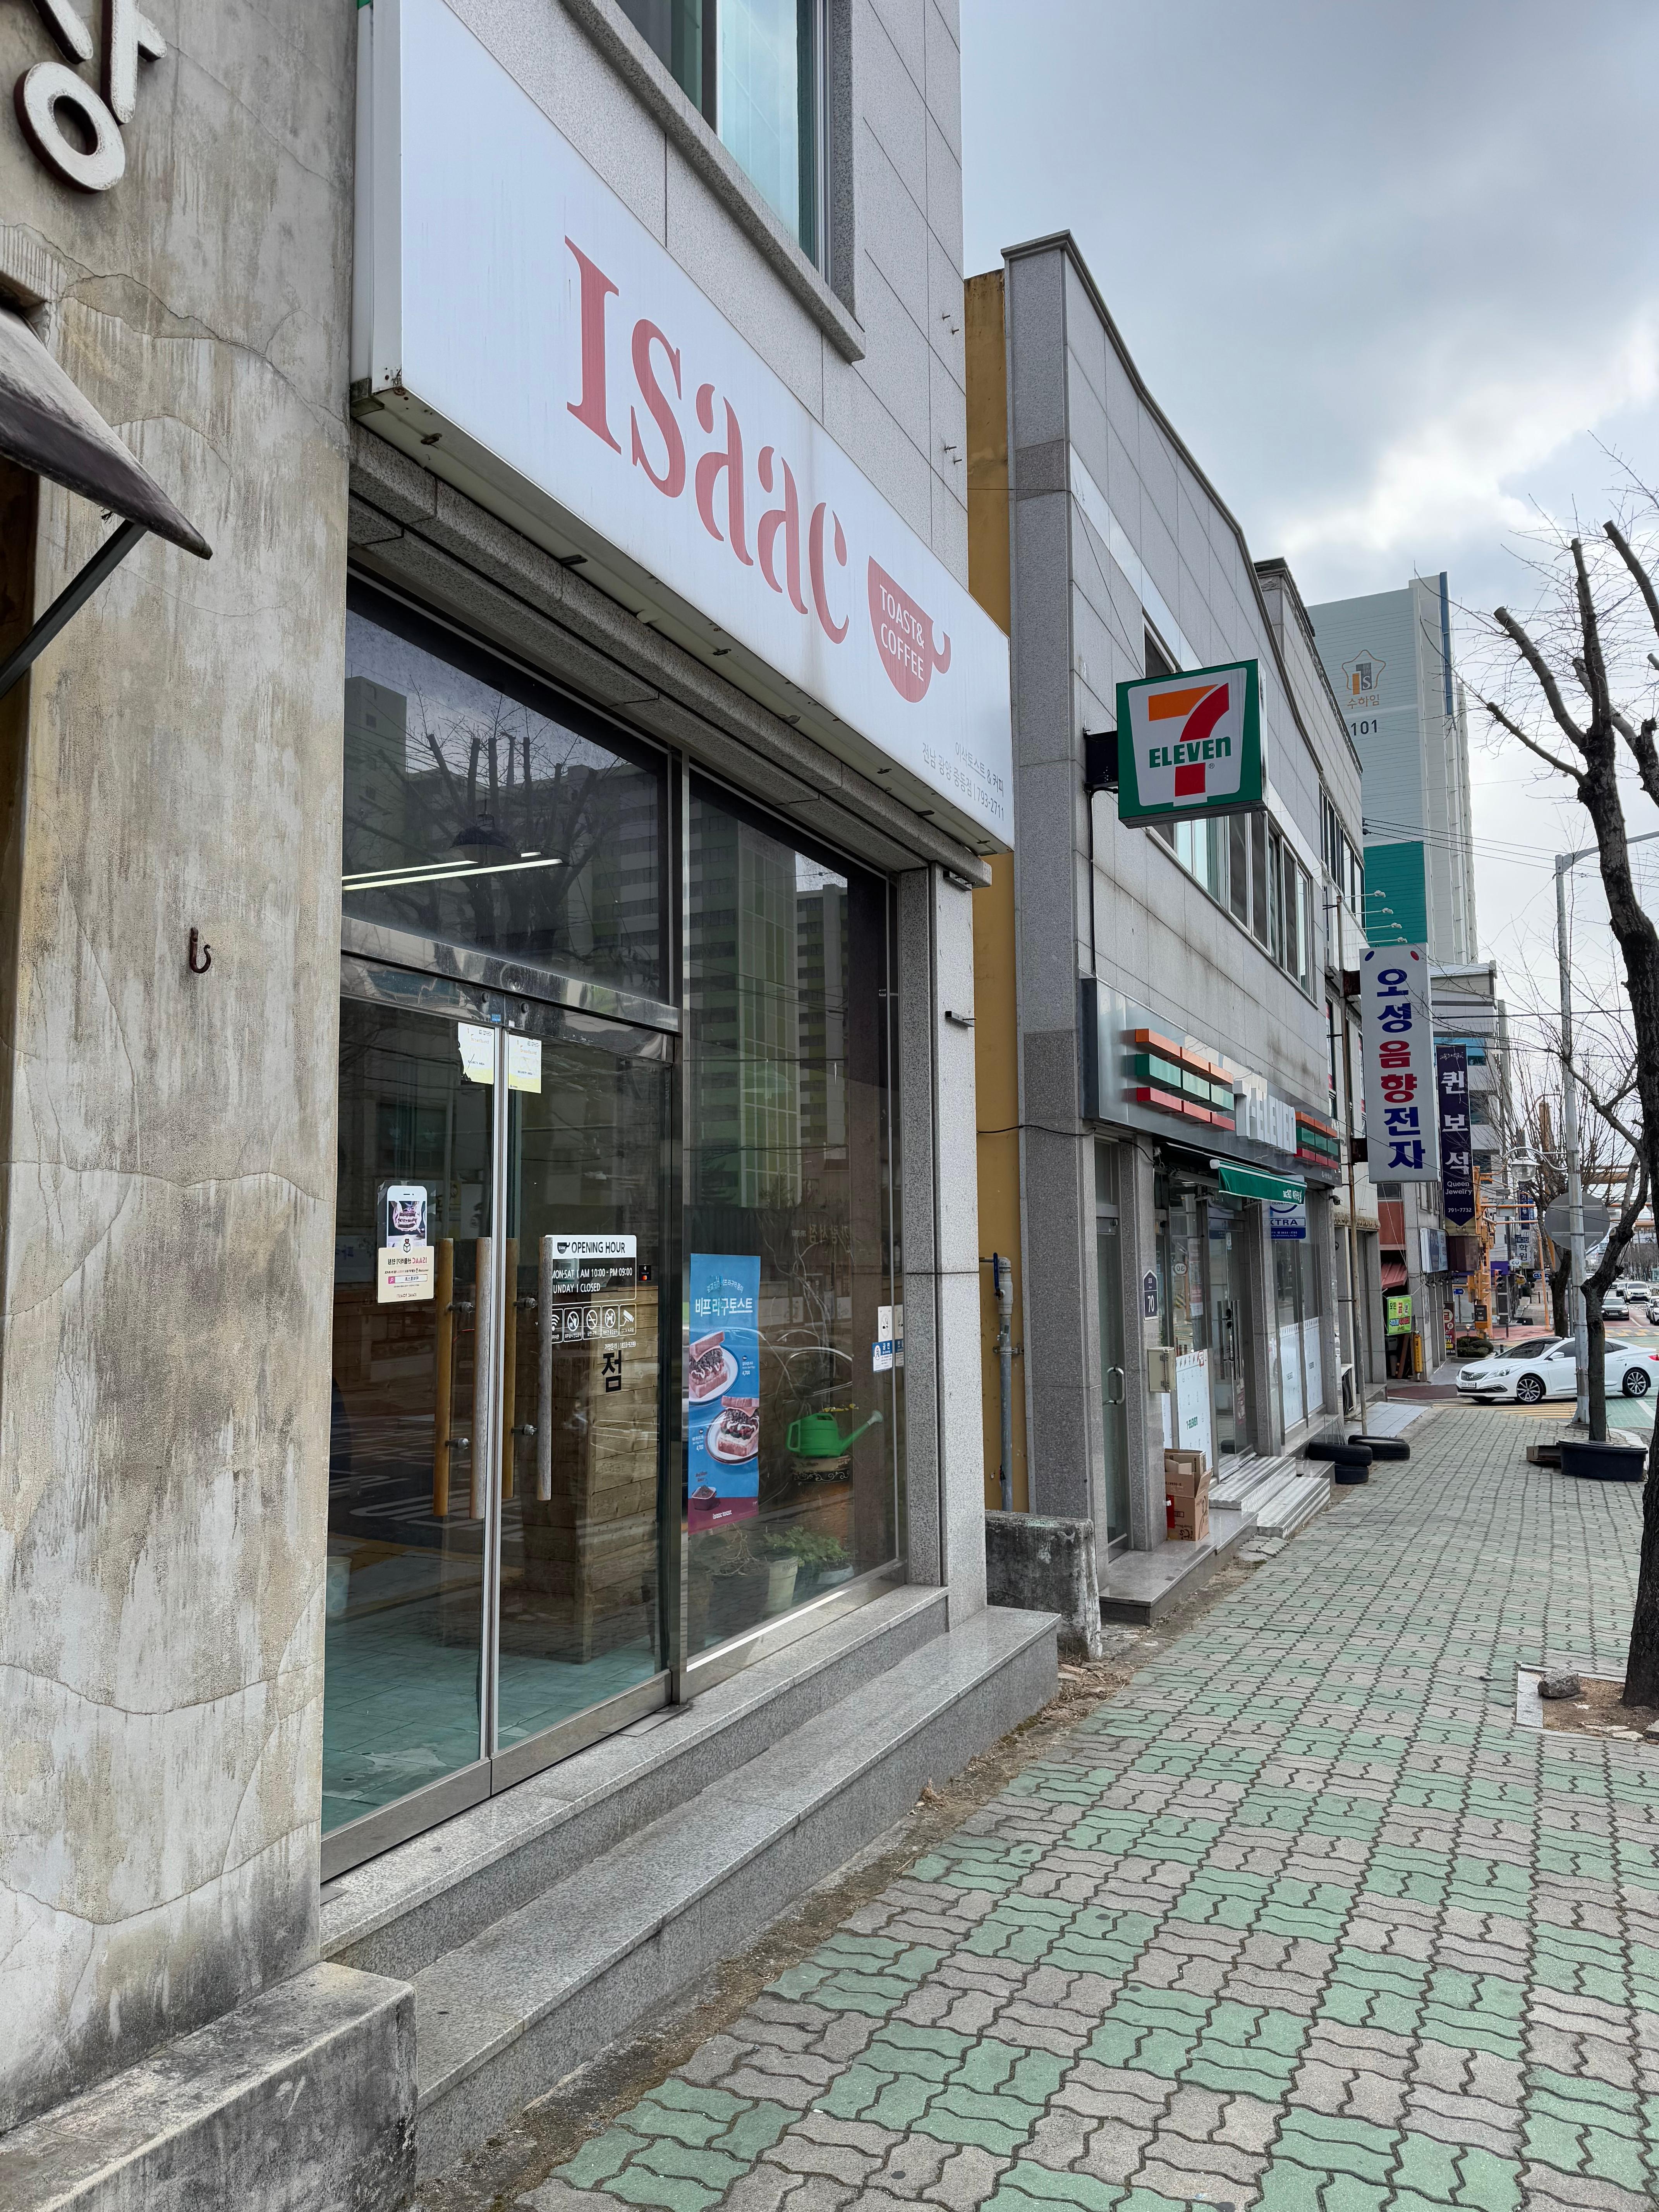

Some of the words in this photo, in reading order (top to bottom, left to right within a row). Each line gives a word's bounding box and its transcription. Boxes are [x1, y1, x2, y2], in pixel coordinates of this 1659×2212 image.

[881, 623, 924, 682] COFFEE
[1347, 694, 1379, 709] 수하임
[1351, 720, 1377, 736] 101
[1148, 682, 1230, 797] 7
[955, 742, 986, 779] 이삭토스트
[993, 774, 1004, 797] 커피
[922, 742, 936, 769] 전남
[939, 755, 951, 780] 광양
[953, 767, 972, 797] 중동점
[977, 787, 1004, 821] 793-2711
[571, 1242, 603, 1254] OPENING
[605, 1242, 625, 1254] HOUR
[1519, 1244, 1528, 1261] 학원
[580, 1268, 590, 1278] AM
[591, 1268, 605, 1278] 10:00
[610, 1267, 618, 1277] PM
[619, 1267, 633, 1276] 09:00
[553, 1284, 575, 1294] UNDAY
[580, 1283, 600, 1292] CLOSED
[1147, 1295, 1154, 1312] 70
